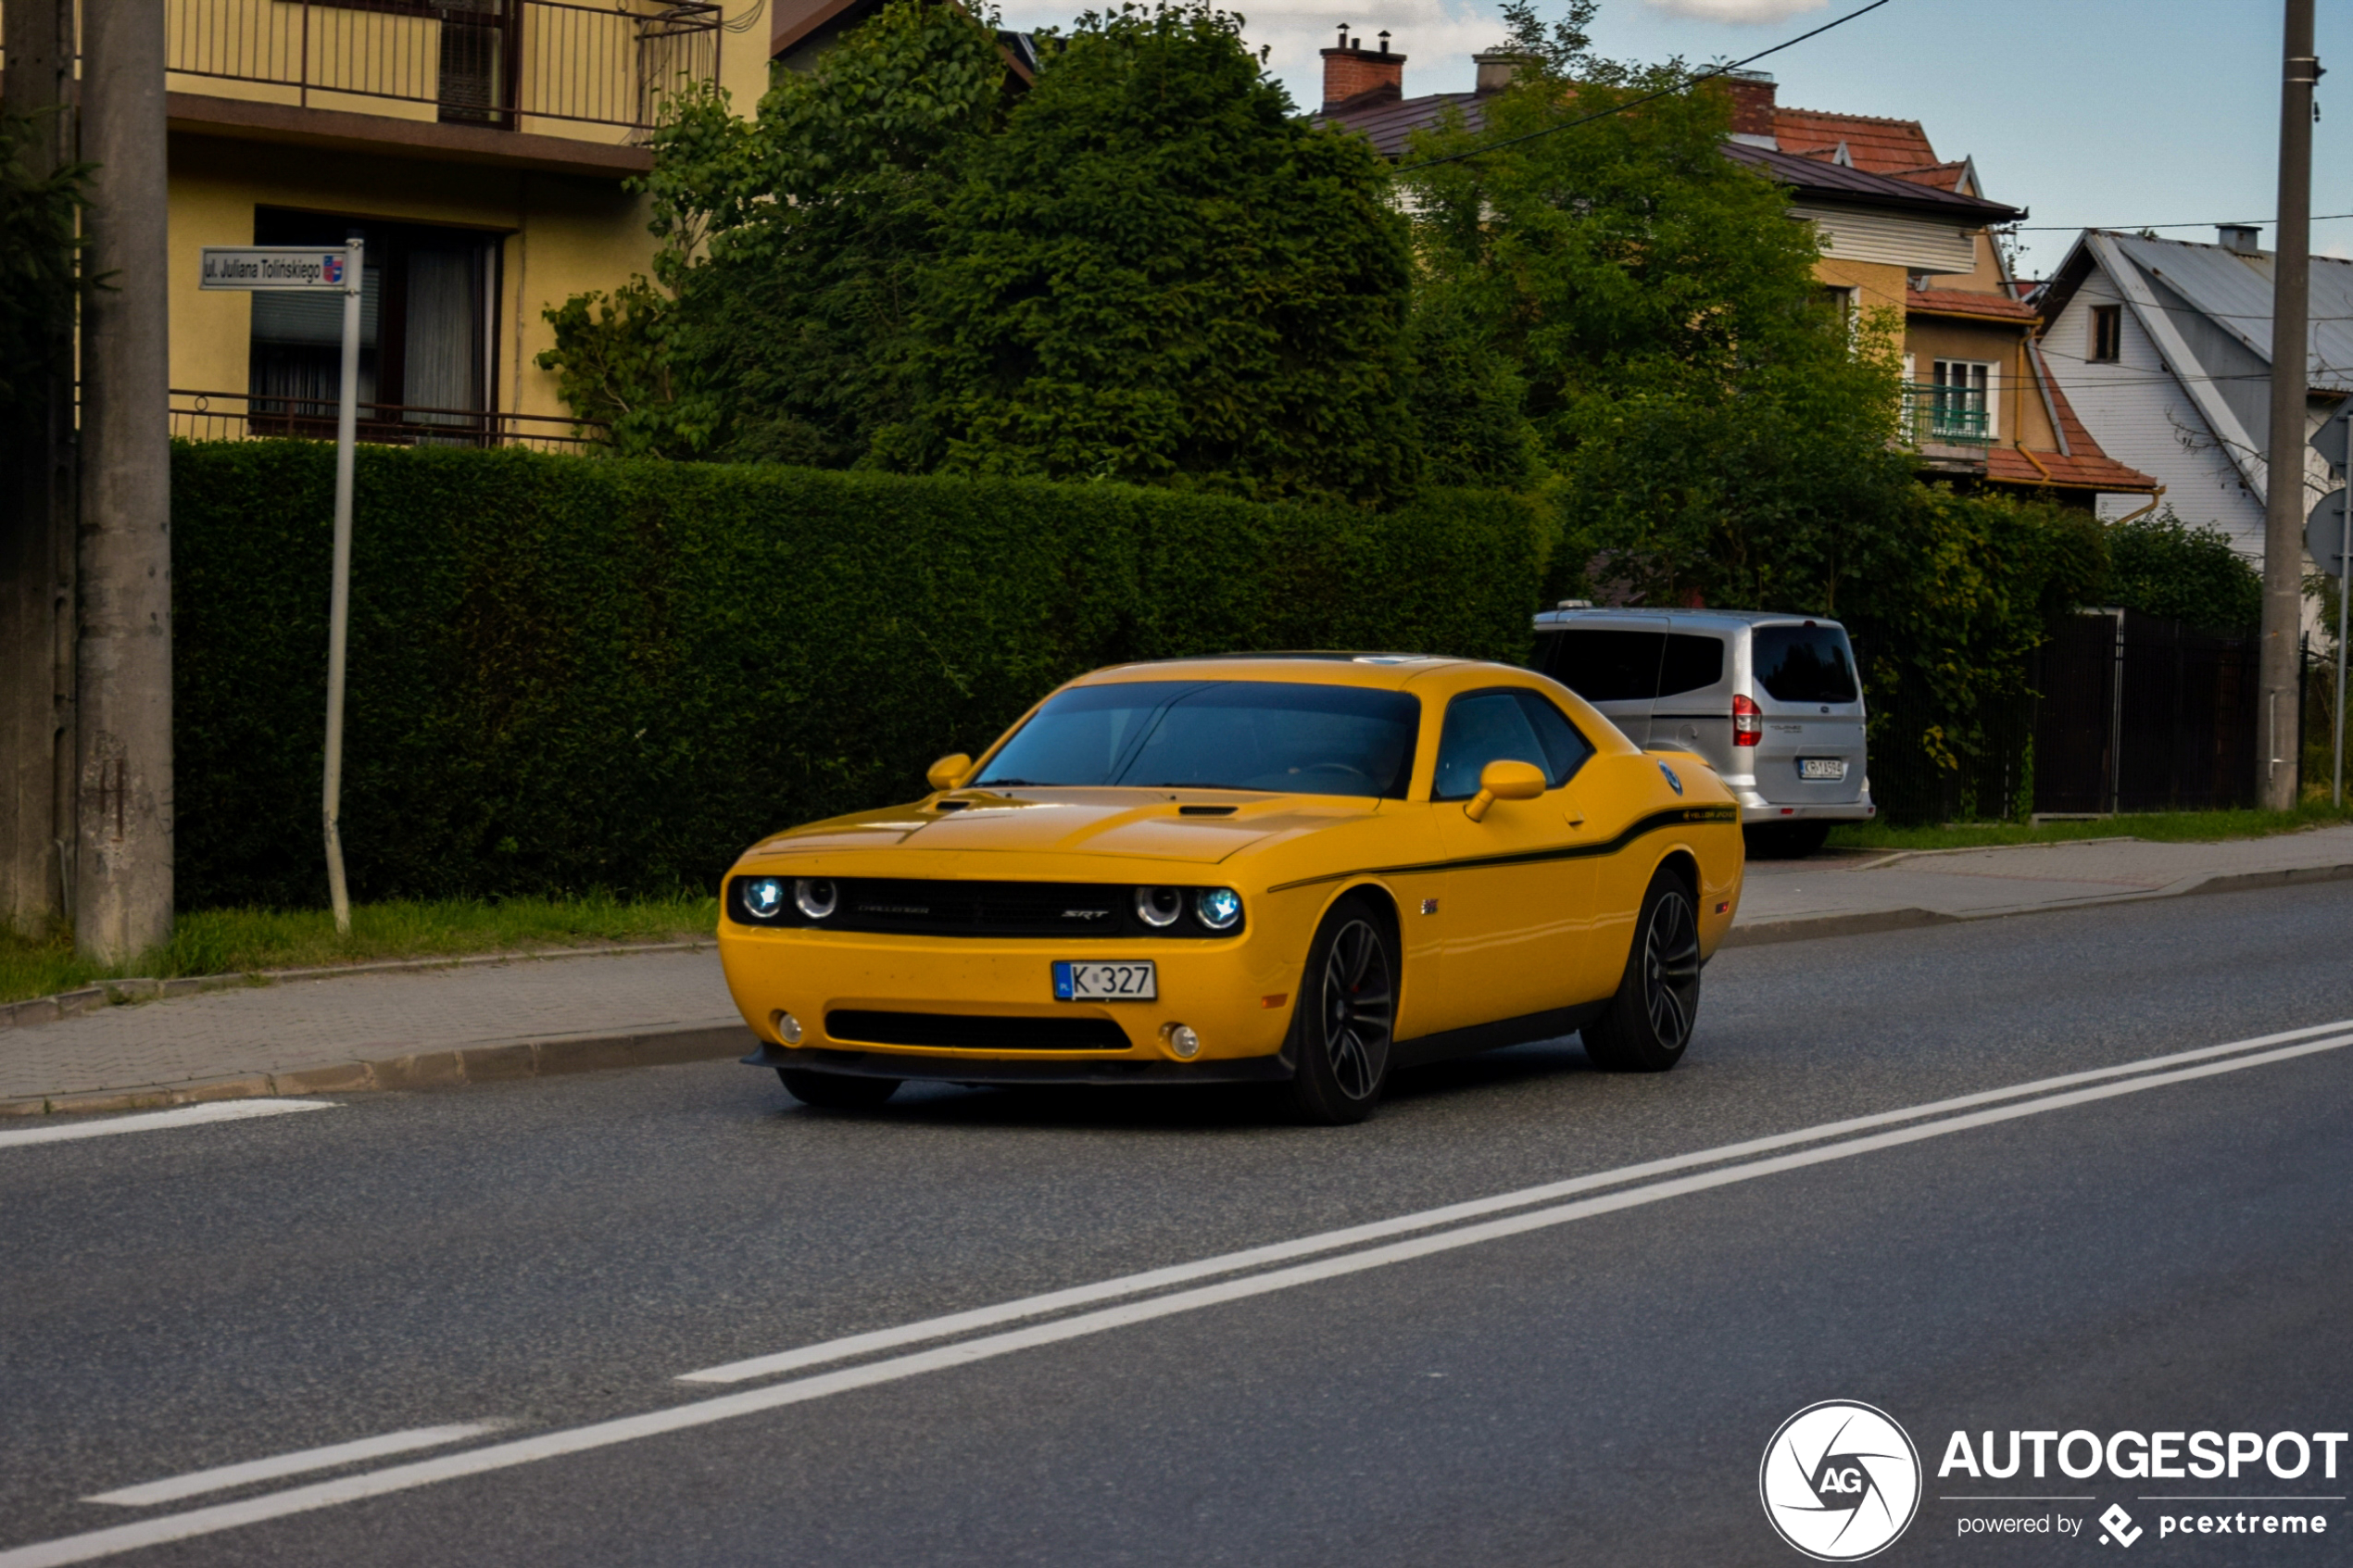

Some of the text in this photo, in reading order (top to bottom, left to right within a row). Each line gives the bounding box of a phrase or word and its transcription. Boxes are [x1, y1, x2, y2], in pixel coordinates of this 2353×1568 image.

[205, 259, 321, 283] ul. Juliana Tolińskiego
[1062, 910, 1109, 920] SRT
[1073, 966, 1150, 993] K 327
